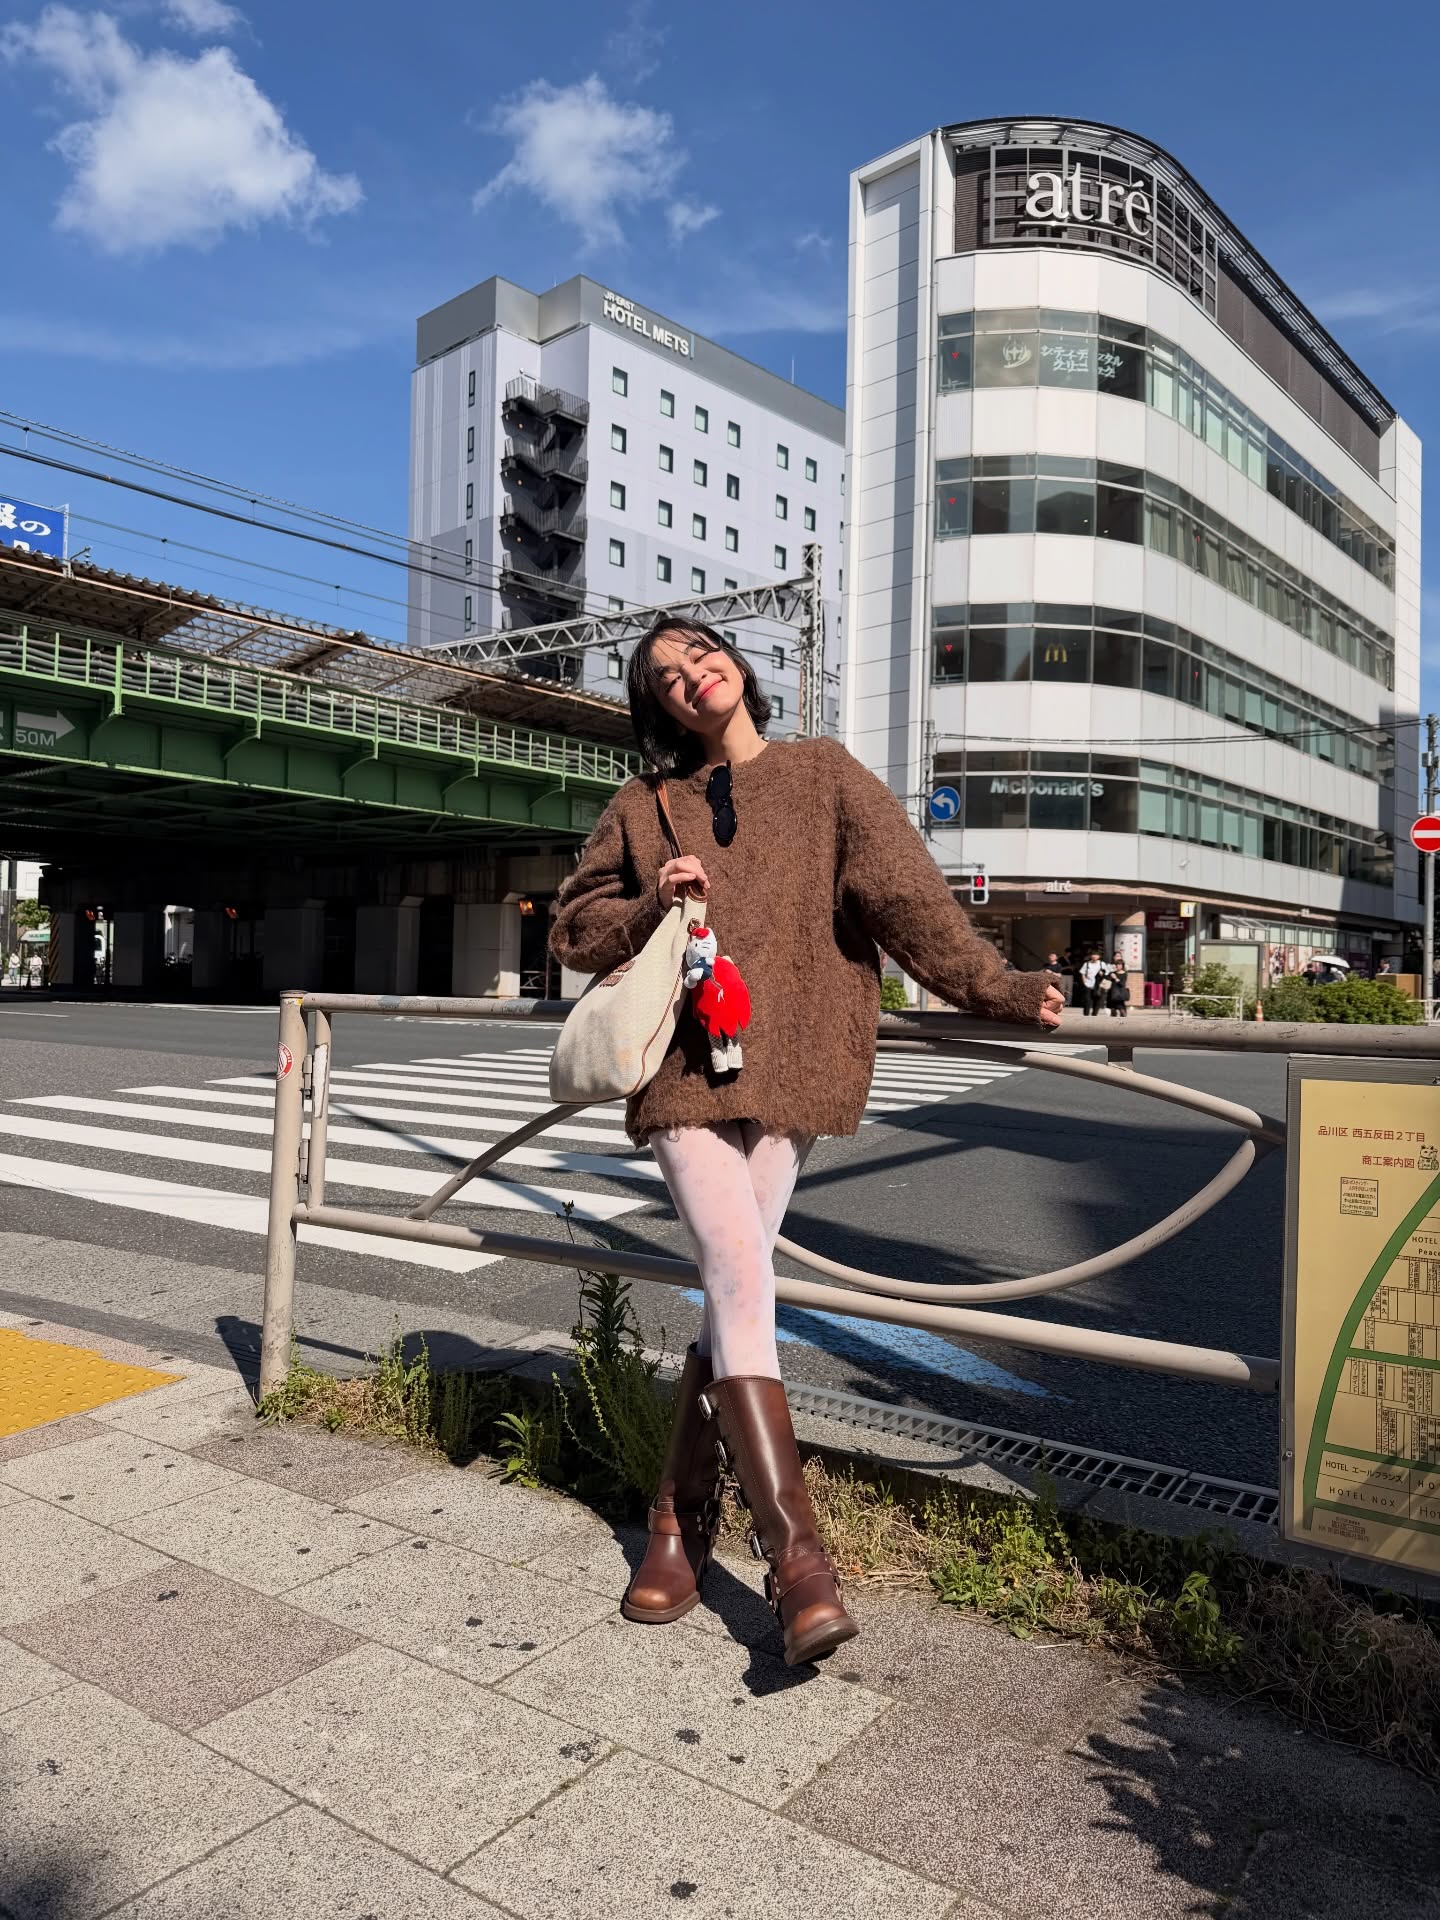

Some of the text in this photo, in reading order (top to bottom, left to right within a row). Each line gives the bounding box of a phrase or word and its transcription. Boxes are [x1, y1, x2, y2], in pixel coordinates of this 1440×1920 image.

[1025, 162, 1151, 236] atré
[603, 300, 690, 357] HOTEL METS
[15, 728, 55, 747] 50M
[1045, 880, 1072, 892] atré
[1317, 1125, 1349, 1137] 品川区
[1361, 1155, 1415, 1168] 商工案内図
[1411, 1236, 1438, 1245] HOTEL
[1325, 1460, 1349, 1472] HOTEL
[1329, 1486, 1396, 1508] HOTEL NOX
